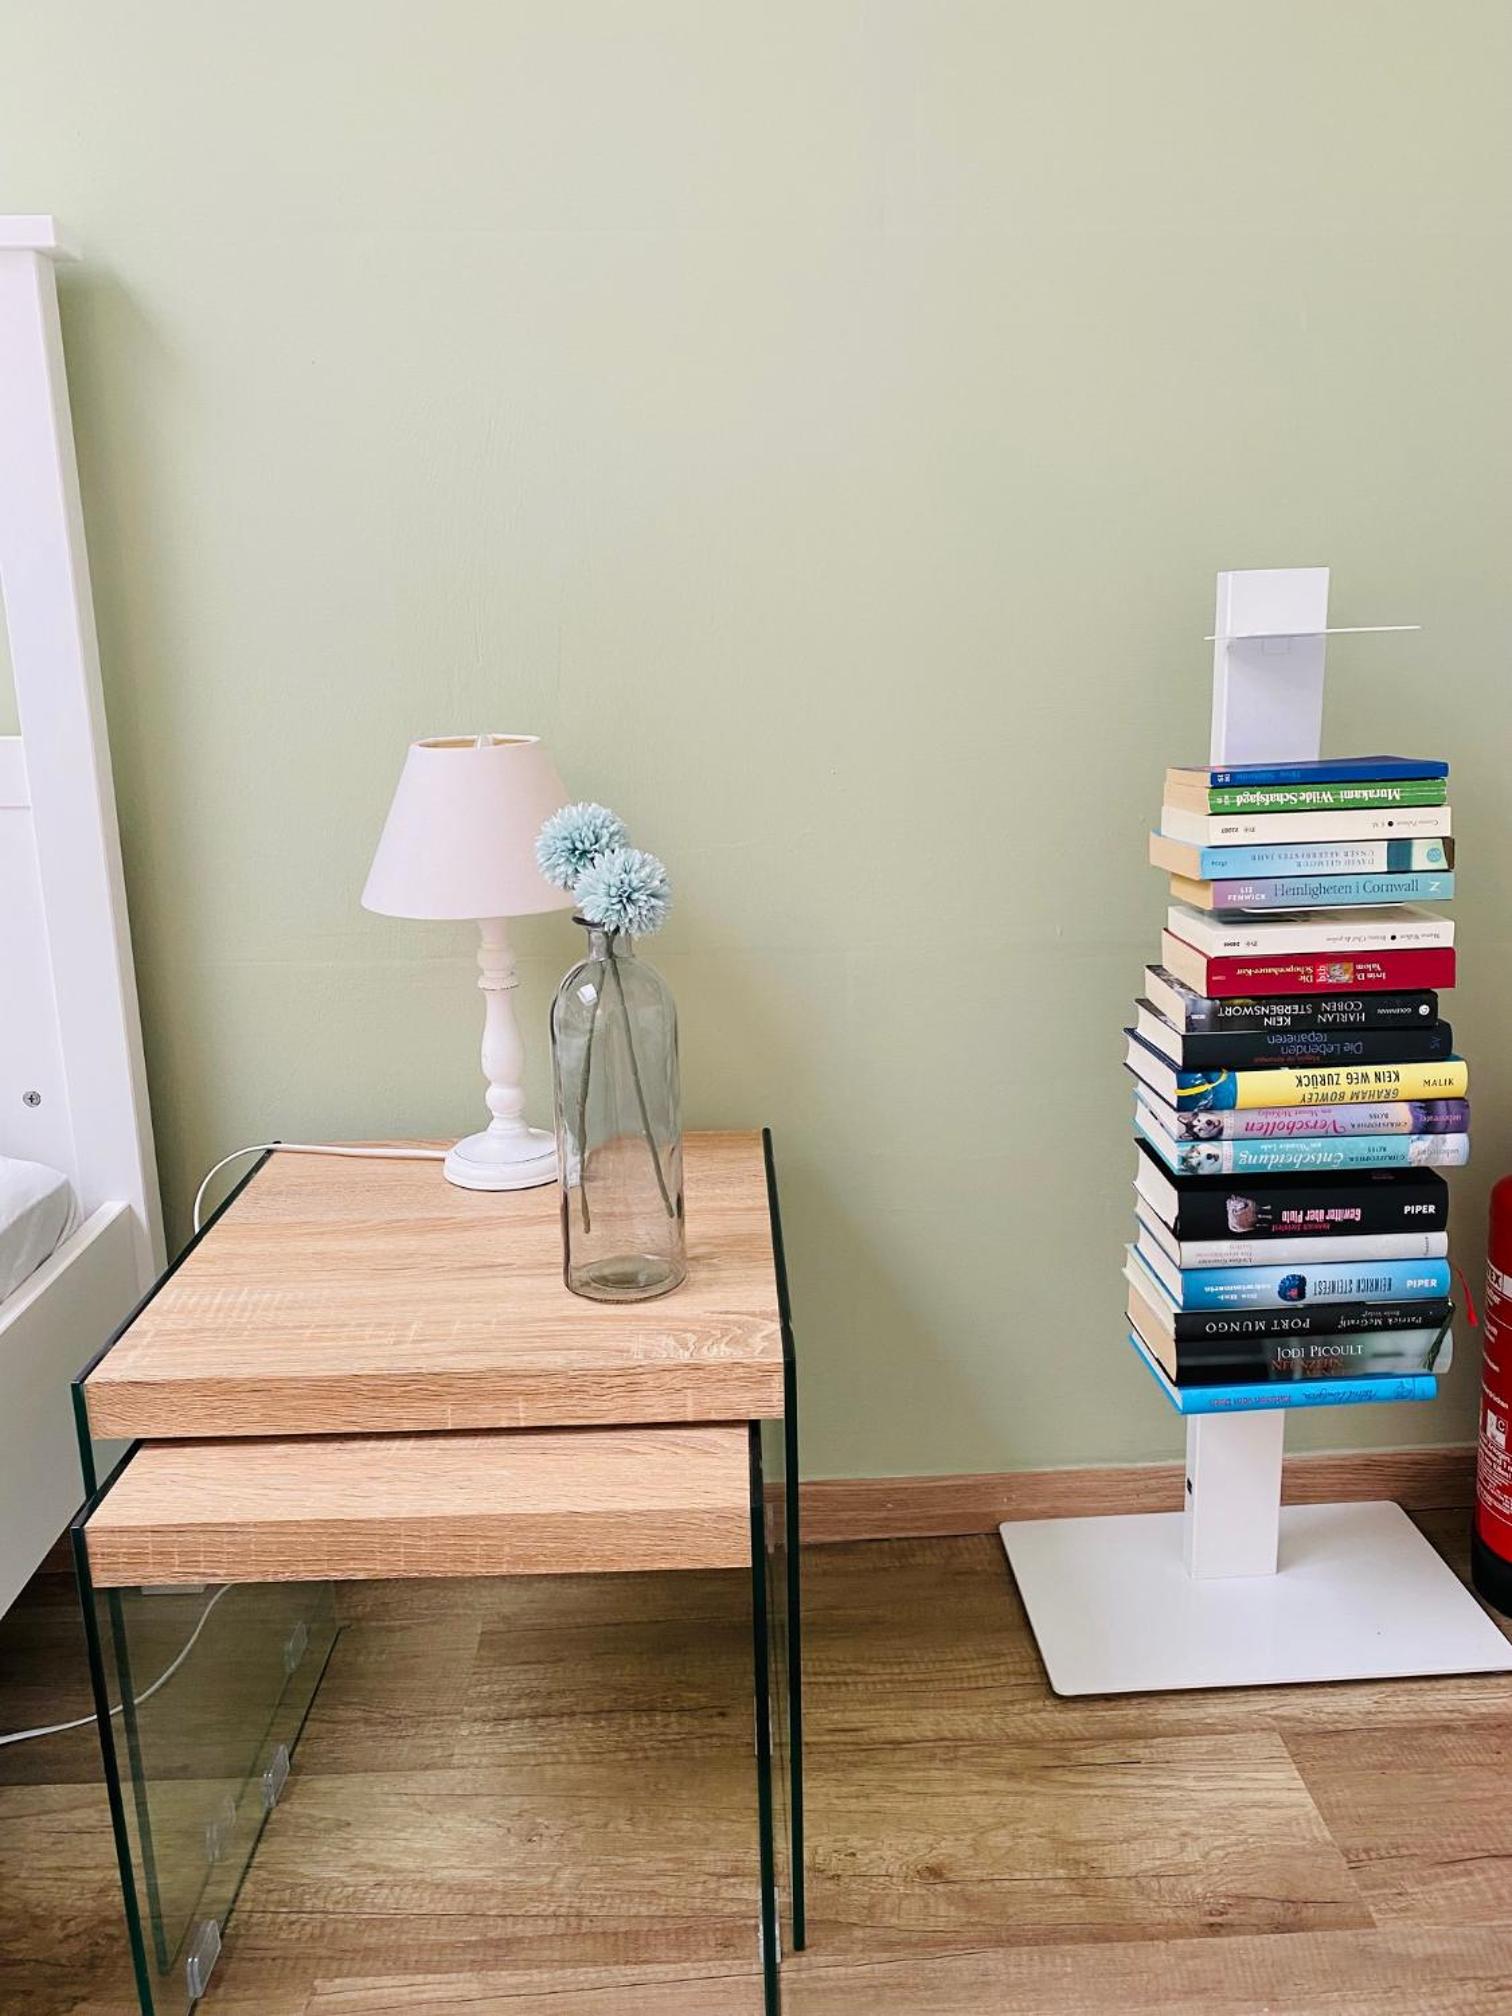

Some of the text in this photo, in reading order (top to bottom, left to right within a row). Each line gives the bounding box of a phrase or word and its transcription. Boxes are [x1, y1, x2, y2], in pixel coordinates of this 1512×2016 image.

[1236, 791, 1298, 806] Schafsjagd
[1299, 791, 1334, 804] Wilde
[1340, 788, 1401, 801] Murakami
[1274, 882, 1352, 900] Hemligheten
[1362, 880, 1419, 893] Cornwall
[1236, 965, 1314, 976] Schopenhauer-Kur
[1356, 963, 1381, 971] Yalom
[1298, 974, 1314, 984] Die
[1366, 972, 1386, 980] Irvin
[1218, 1004, 1312, 1016] STERBENSWORT
[1321, 1001, 1363, 1012] COBEN
[1264, 1016, 1291, 1026] KEIN
[1318, 1012, 1366, 1023] HARLAN
[1280, 1041, 1364, 1056] Die Lebenden
[1295, 1070, 1400, 1089] KEIN WEG ZURÜCK
[1423, 1078, 1454, 1087] MALIK
[1298, 1088, 1400, 1104] GRAHAM BOWLEY
[1244, 1119, 1346, 1136] Verschollen
[1238, 1150, 1344, 1171] Entscheidung
[1404, 1204, 1436, 1214] PIPER
[1281, 1208, 1361, 1224] Gewitter über Pluto
[1312, 1277, 1392, 1296] HEINRICH STEINFEST
[1406, 1278, 1438, 1288] PIPER
[1204, 1318, 1310, 1334] PORT MUNGO
[1340, 1316, 1422, 1328] Patrick McGrath
[1277, 1344, 1364, 1360] JODI PICOULT
